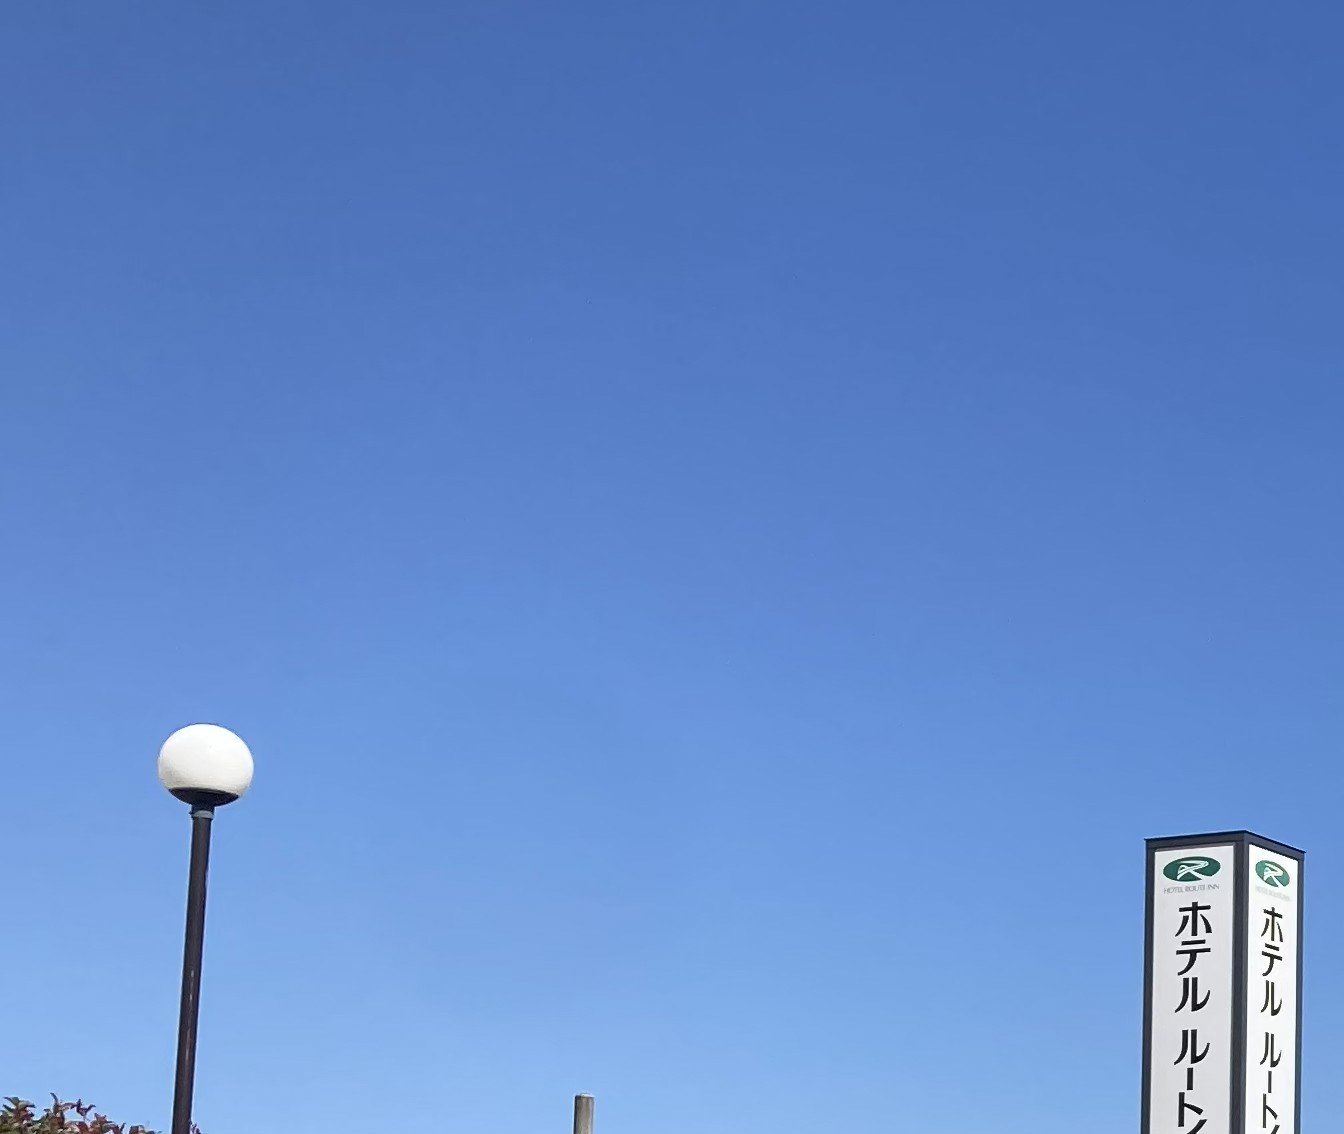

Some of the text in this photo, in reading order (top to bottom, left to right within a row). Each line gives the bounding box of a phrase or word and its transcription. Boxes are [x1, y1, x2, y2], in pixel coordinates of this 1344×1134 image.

[1163, 886, 1183, 894] HOTEL
[1174, 901, 1212, 1014] ホテル
[1260, 906, 1283, 1017] ホテル
